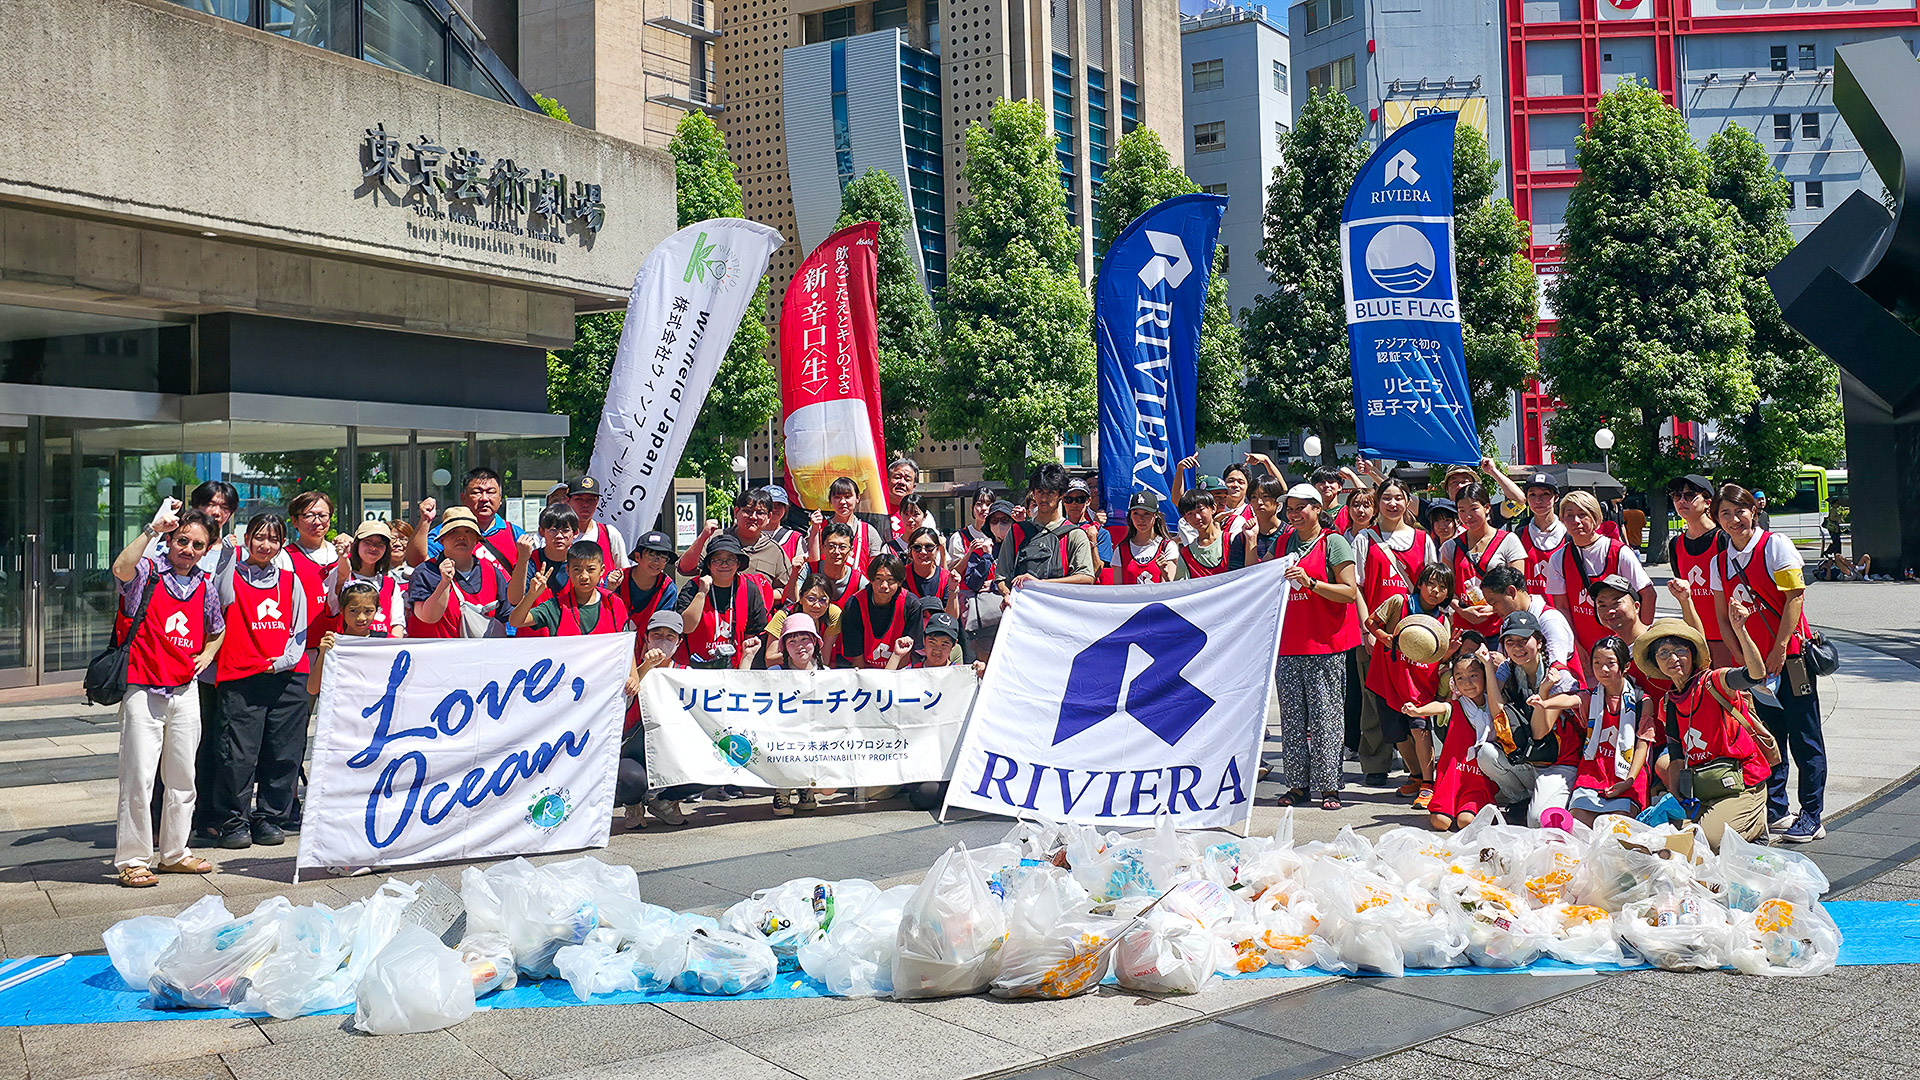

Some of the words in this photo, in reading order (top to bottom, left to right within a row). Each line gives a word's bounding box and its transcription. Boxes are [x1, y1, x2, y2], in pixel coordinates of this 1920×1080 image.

[363, 122, 606, 233] 東京芸術劇場
[1370, 189, 1431, 204] RIVIERA
[415, 204, 446, 223] Tokyo
[450, 212, 524, 237] Metropolitan
[834, 246, 851, 395] 飲みごたえとキレのよさ
[1355, 300, 1403, 319] BLUE
[1408, 300, 1455, 319] FLAG
[1374, 337, 1441, 350] アジアで初の
[669, 310, 710, 404] Winfield
[1376, 350, 1441, 364] 認証マリーナ
[1384, 376, 1444, 395] リビエラ
[1131, 294, 1173, 502] RIVIERA
[1367, 398, 1464, 417] 逗子マリーナ
[640, 408, 675, 477] Japan
[610, 484, 647, 522] Co.,
[1289, 593, 1309, 602] IERA
[1692, 588, 1715, 596] IERA
[346, 649, 586, 769] Love,
[678, 687, 943, 715] リビエラビーチクリーン
[767, 738, 909, 752] リビエラ未来づくりプロジェクト
[766, 754, 801, 763] RIVIERA
[804, 753, 866, 763] SUSTAINABILITY
[869, 752, 909, 762] PROJECTS
[1456, 761, 1482, 777] RIVIE
[363, 728, 591, 849] Ocean
[970, 750, 1247, 818] RIVIERA
